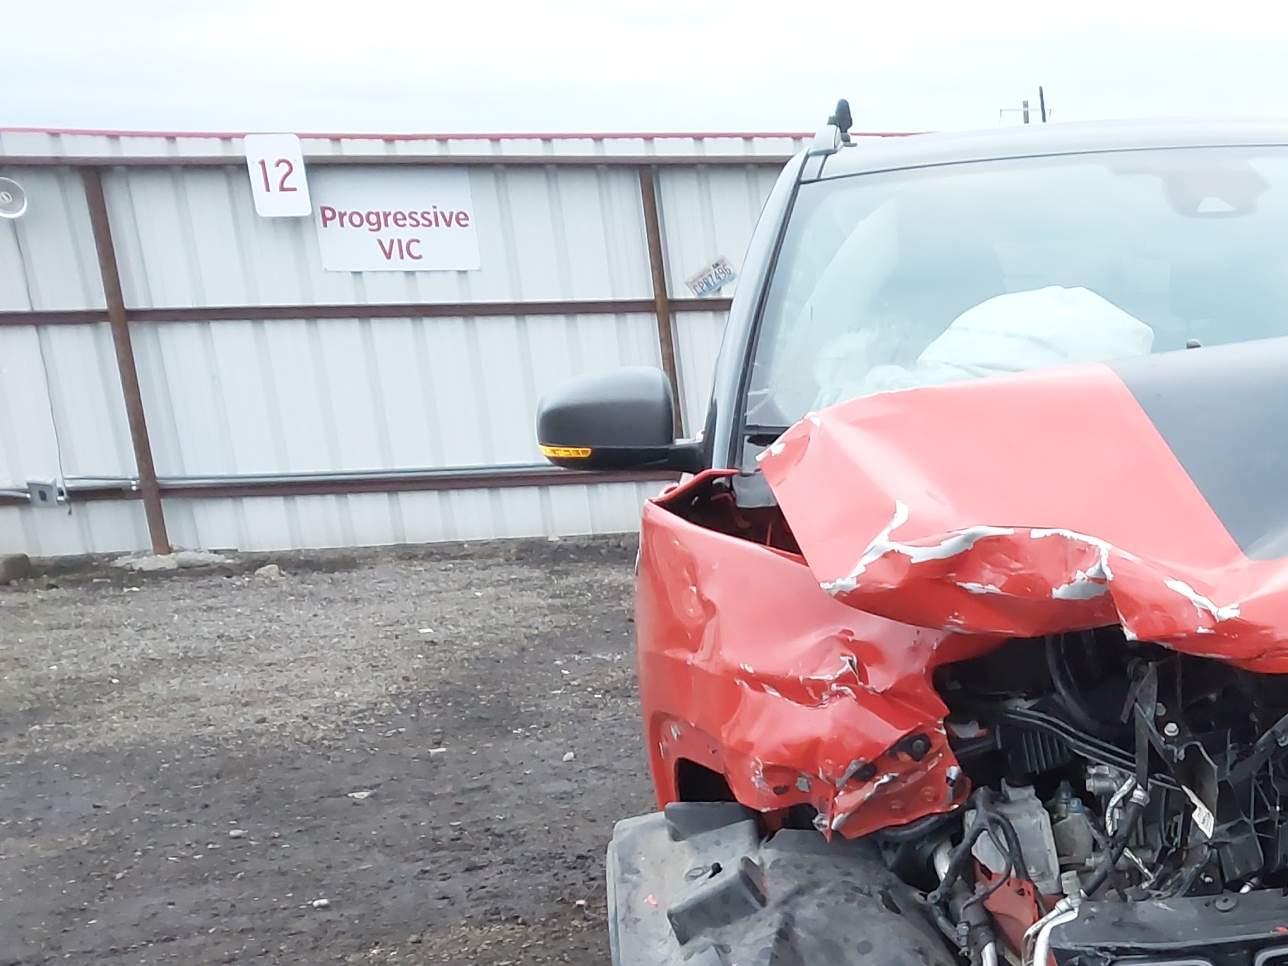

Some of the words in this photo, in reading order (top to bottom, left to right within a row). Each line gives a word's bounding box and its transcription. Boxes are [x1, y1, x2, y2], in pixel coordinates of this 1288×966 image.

[258, 158, 298, 193] 12
[319, 205, 470, 233] Progressive
[377, 238, 424, 261] VIC
